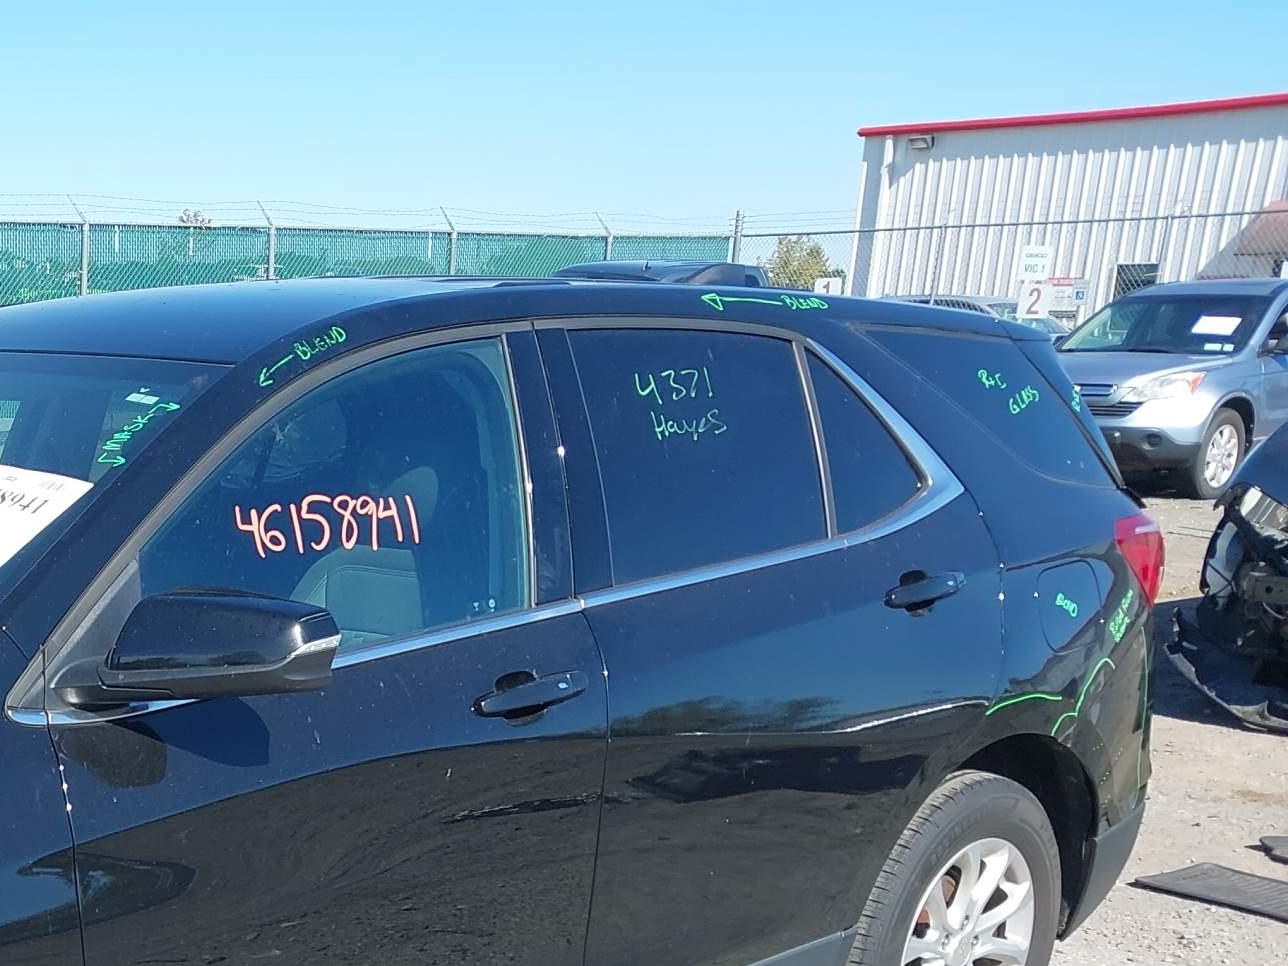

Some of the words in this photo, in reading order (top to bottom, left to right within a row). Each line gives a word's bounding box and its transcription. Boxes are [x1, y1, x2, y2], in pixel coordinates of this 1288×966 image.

[1024, 263, 1038, 273] VIC
[781, 294, 829, 310] BLEND
[822, 280, 831, 294] 1
[1025, 287, 1041, 315] 2
[293, 326, 347, 361] BLEND
[634, 366, 713, 405] 4371
[101, 414, 154, 451] MASK
[650, 408, 728, 441] Hayes
[234, 494, 421, 558] 46158941
